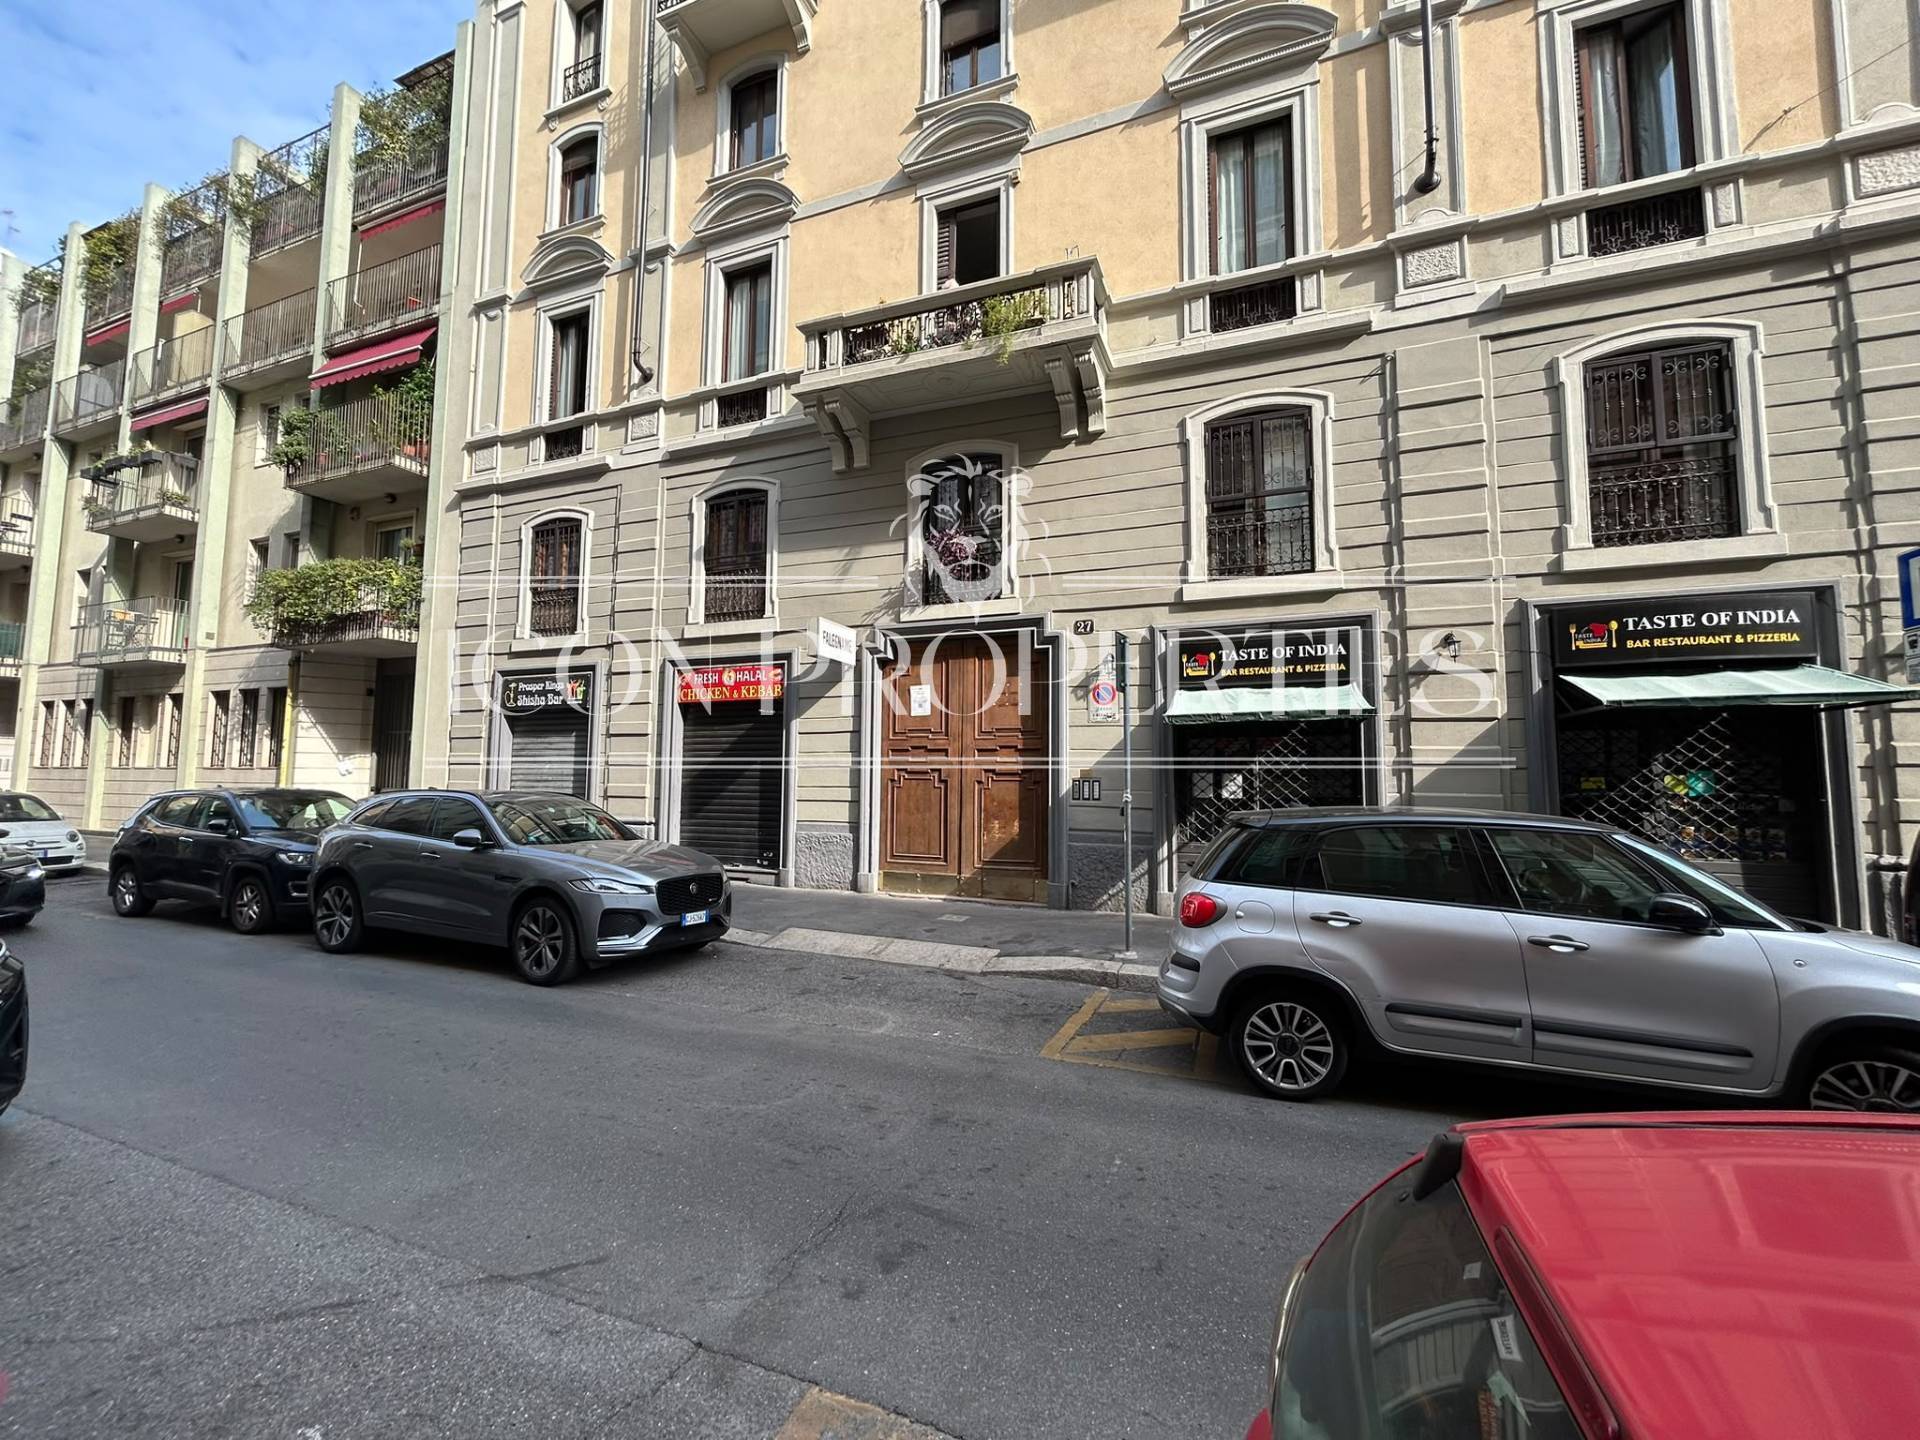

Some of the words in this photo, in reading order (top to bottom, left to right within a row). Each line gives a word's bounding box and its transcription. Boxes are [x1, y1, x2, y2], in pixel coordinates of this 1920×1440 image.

[1077, 621, 1092, 633] 27
[1622, 613, 1696, 631] TASTE
[1701, 611, 1733, 627] OF
[1736, 609, 1800, 625] INDIA
[1626, 638, 1650, 649] BAR
[1653, 635, 1732, 648] RESTAURANT
[1734, 634, 1744, 644] &
[1747, 632, 1800, 643] PIZZERIA
[1219, 647, 1269, 662] TASTE
[1272, 645, 1295, 659] OF
[1298, 643, 1347, 658] INDIA
[694, 672, 719, 684] FRESH
[736, 670, 768, 682] HALAL
[1221, 667, 1238, 677] BAR
[1239, 665, 1294, 676] RESTAURANT
[1295, 665, 1303, 673] &
[1305, 662, 1346, 672] PIZZERIA
[517, 694, 546, 706] Shisha
[547, 693, 564, 705] Bar
[680, 686, 730, 700] CHICKEN
[732, 689, 739, 698] &
[741, 684, 783, 698] KEBAB
